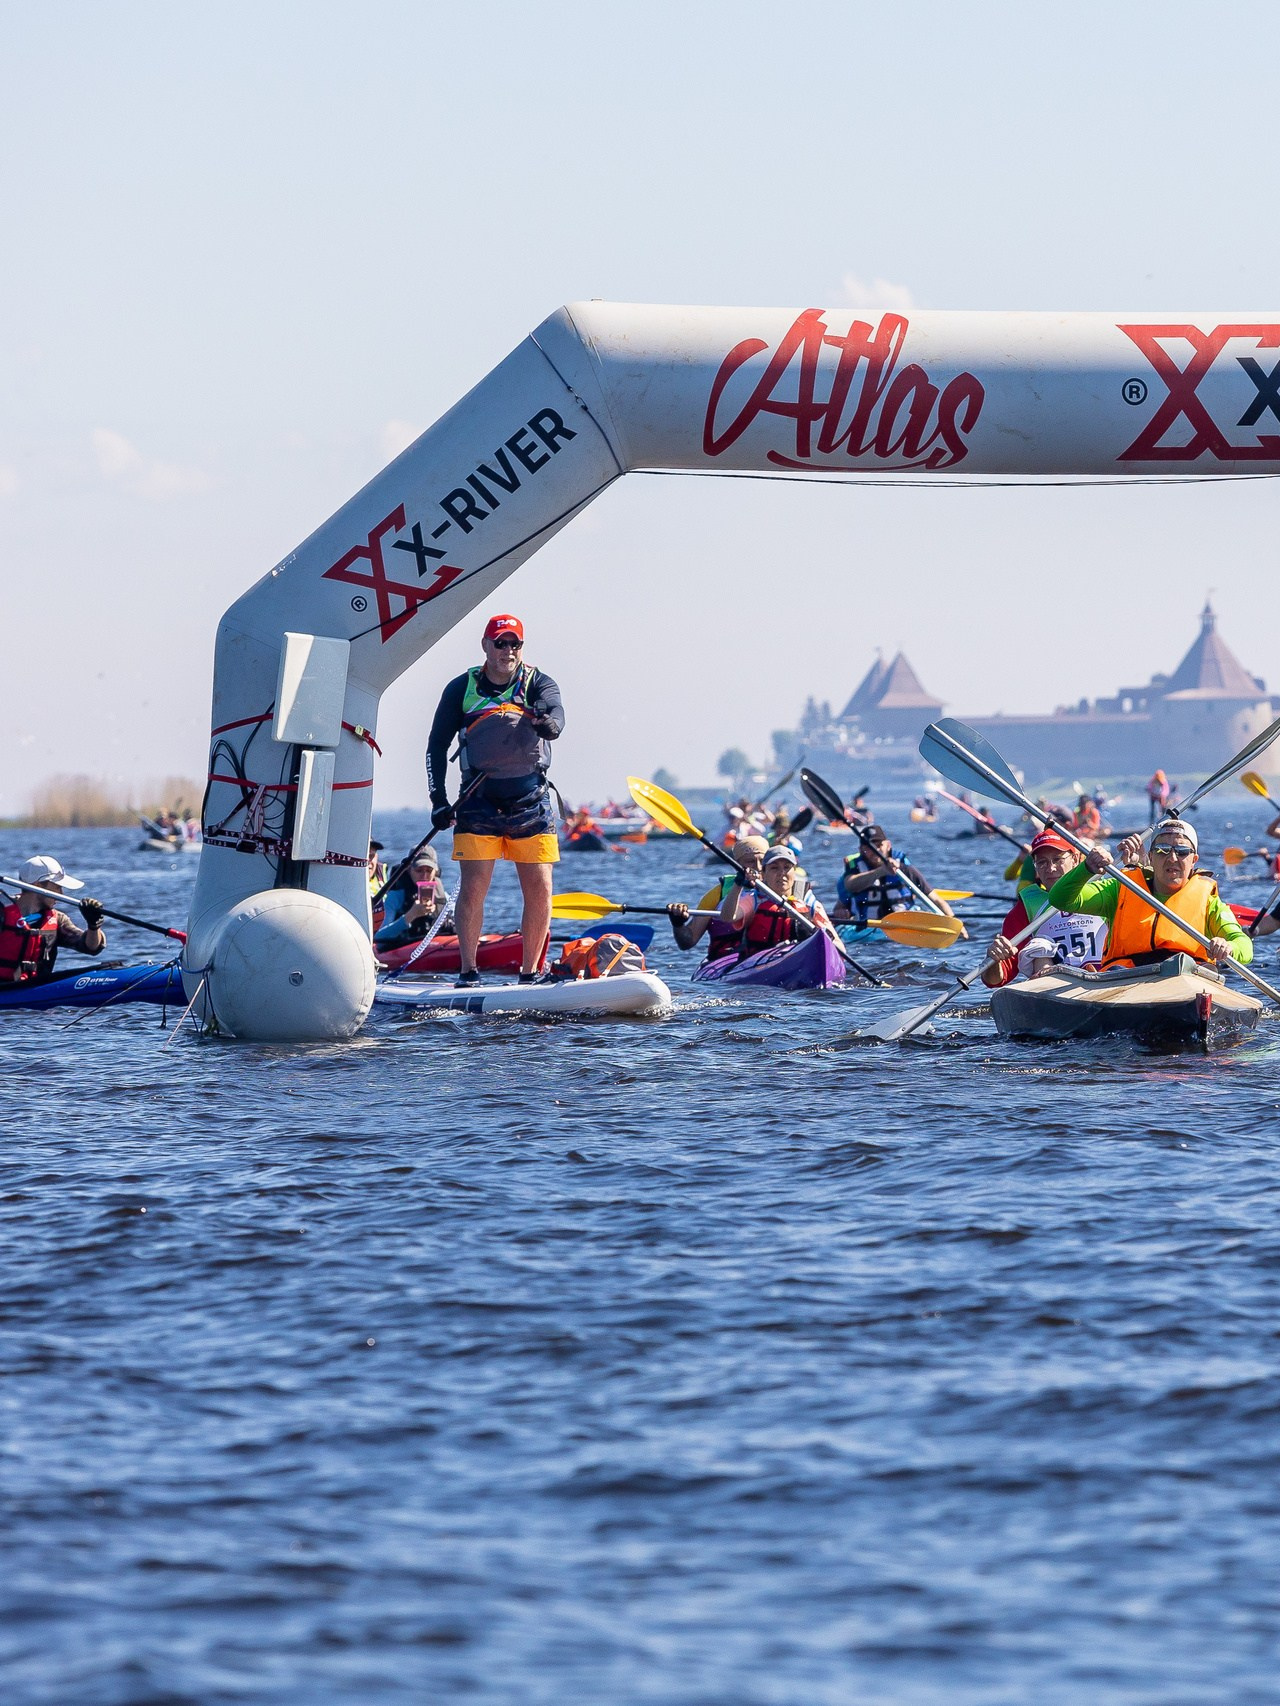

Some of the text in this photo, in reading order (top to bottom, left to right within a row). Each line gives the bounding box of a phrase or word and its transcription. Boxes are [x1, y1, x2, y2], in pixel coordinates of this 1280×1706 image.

[702, 308, 985, 472] Atlas
[391, 407, 578, 578] X-RIVER
[1053, 932, 1096, 958] 551
